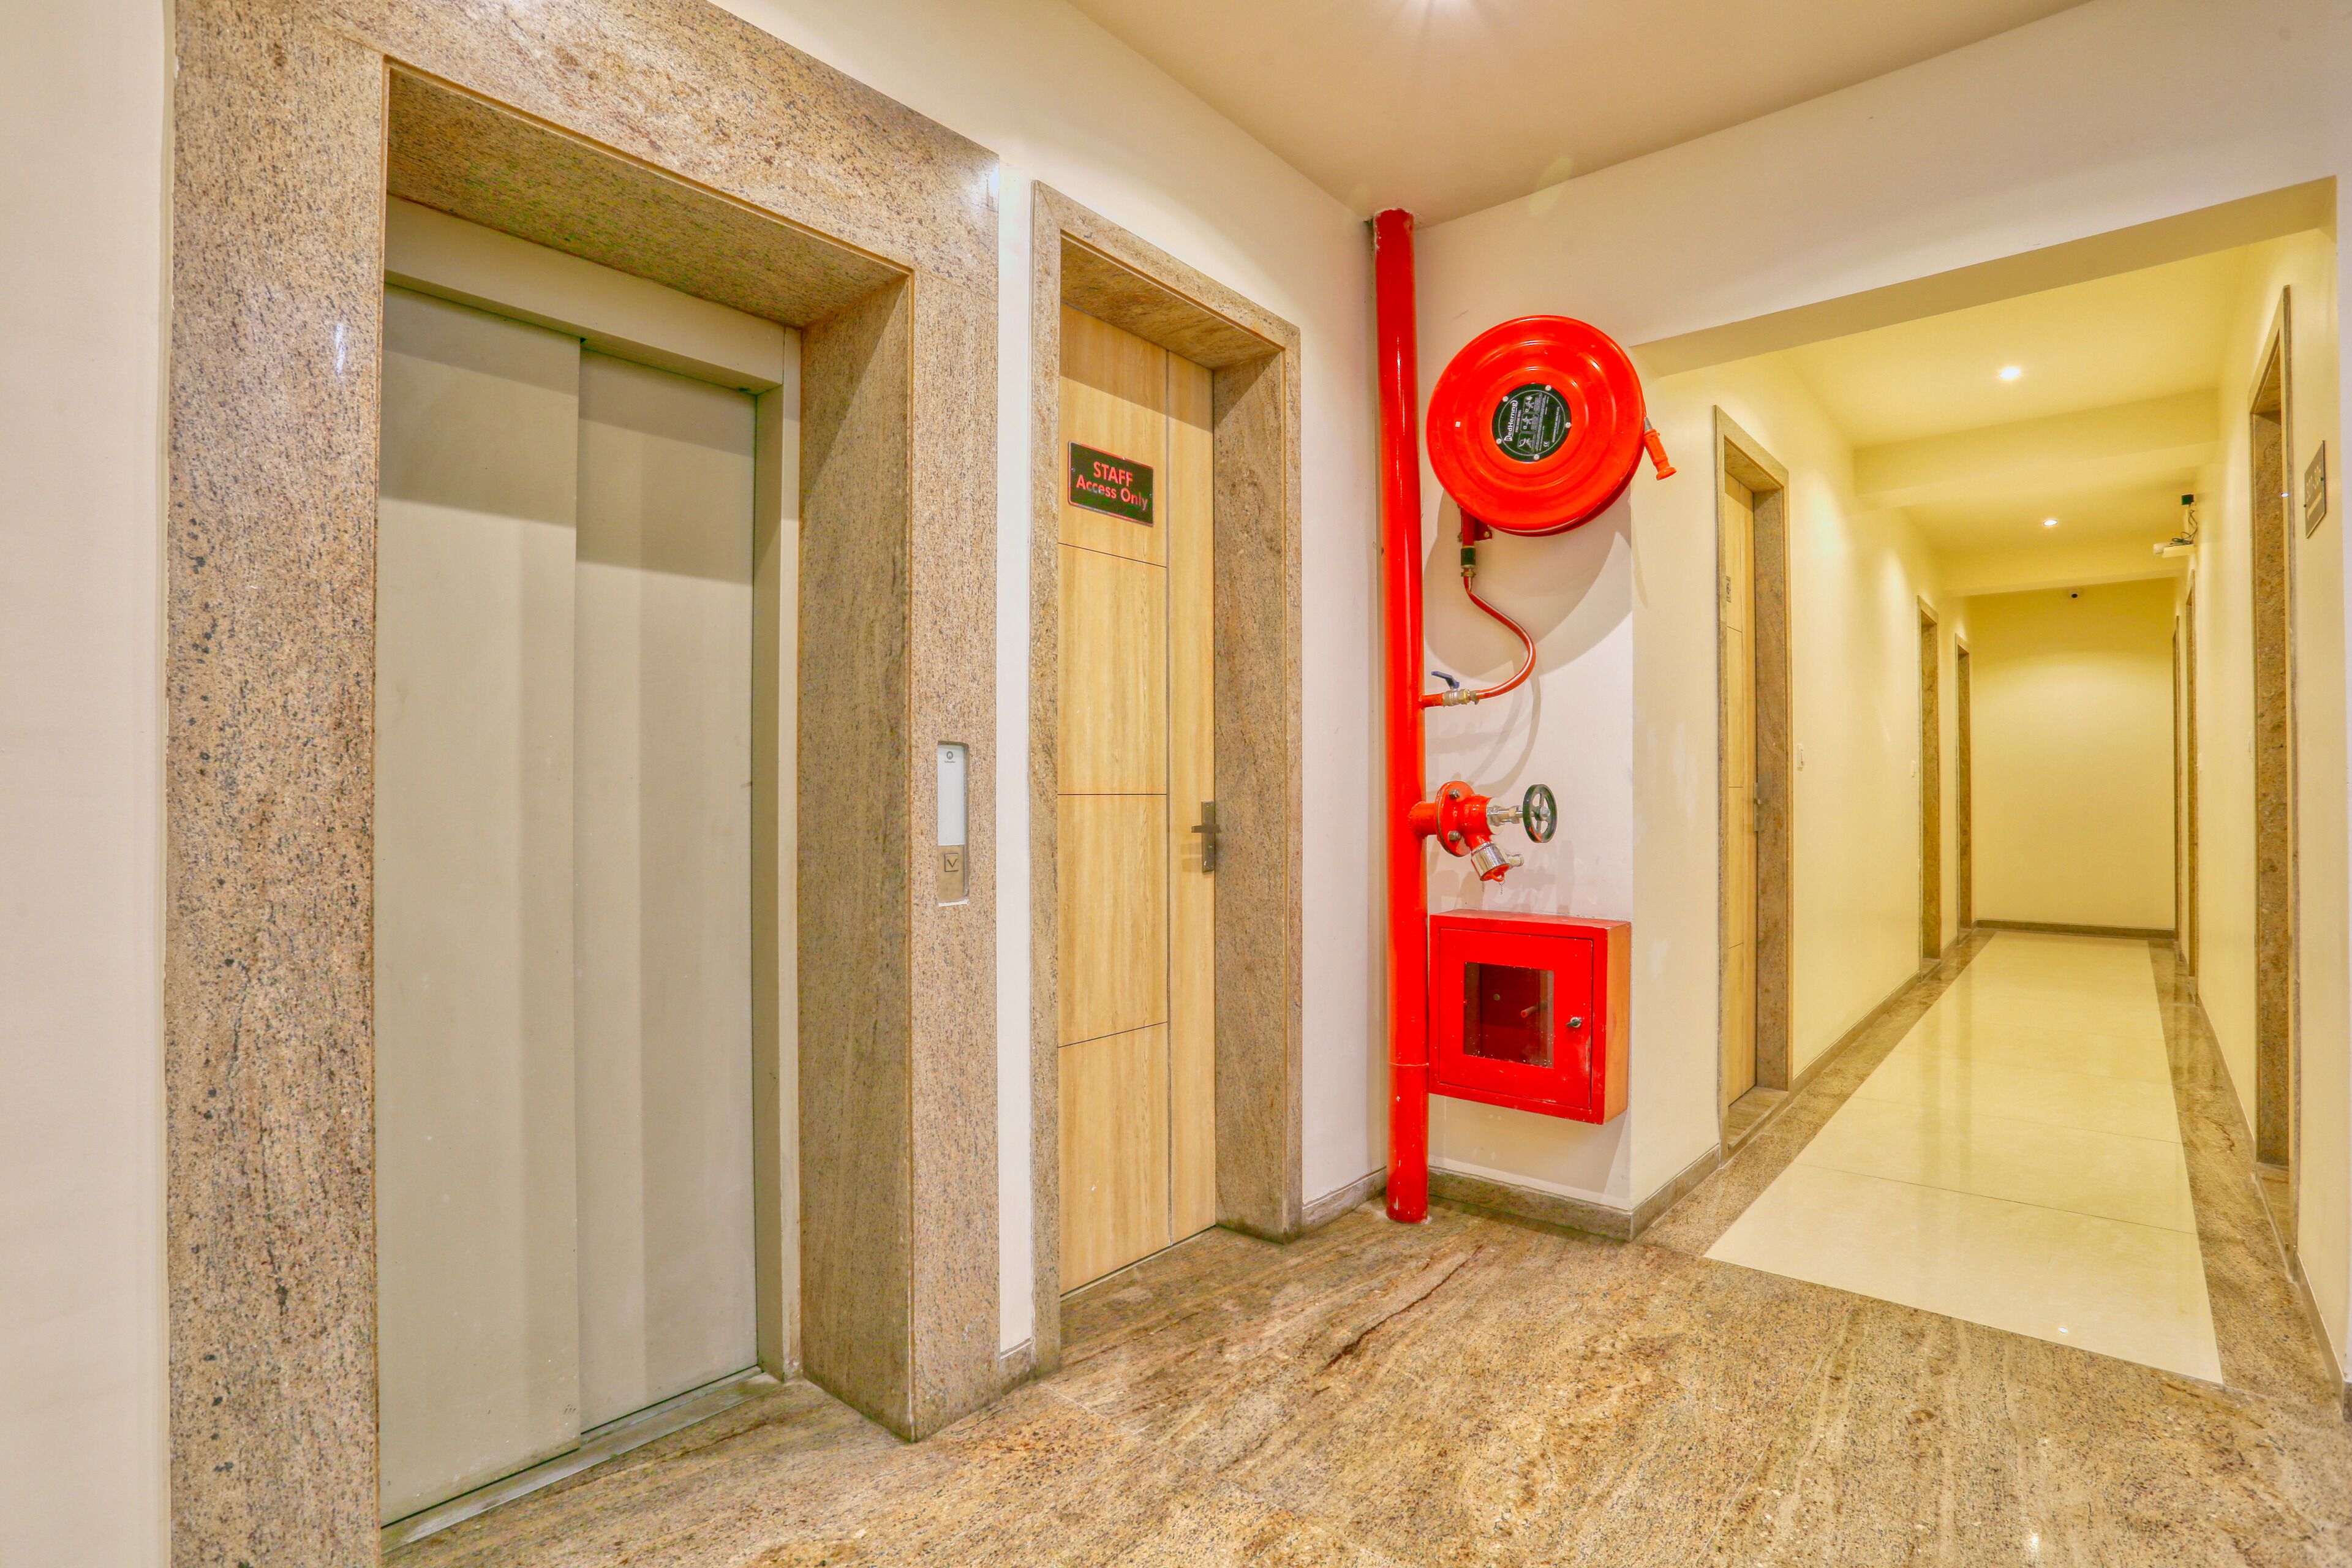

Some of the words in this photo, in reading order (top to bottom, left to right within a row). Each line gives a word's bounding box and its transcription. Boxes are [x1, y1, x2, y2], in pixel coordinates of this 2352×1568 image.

[1093, 461, 1133, 487] STAFF
[1076, 475, 1117, 499] Access
[1120, 488, 1148, 511] Only
